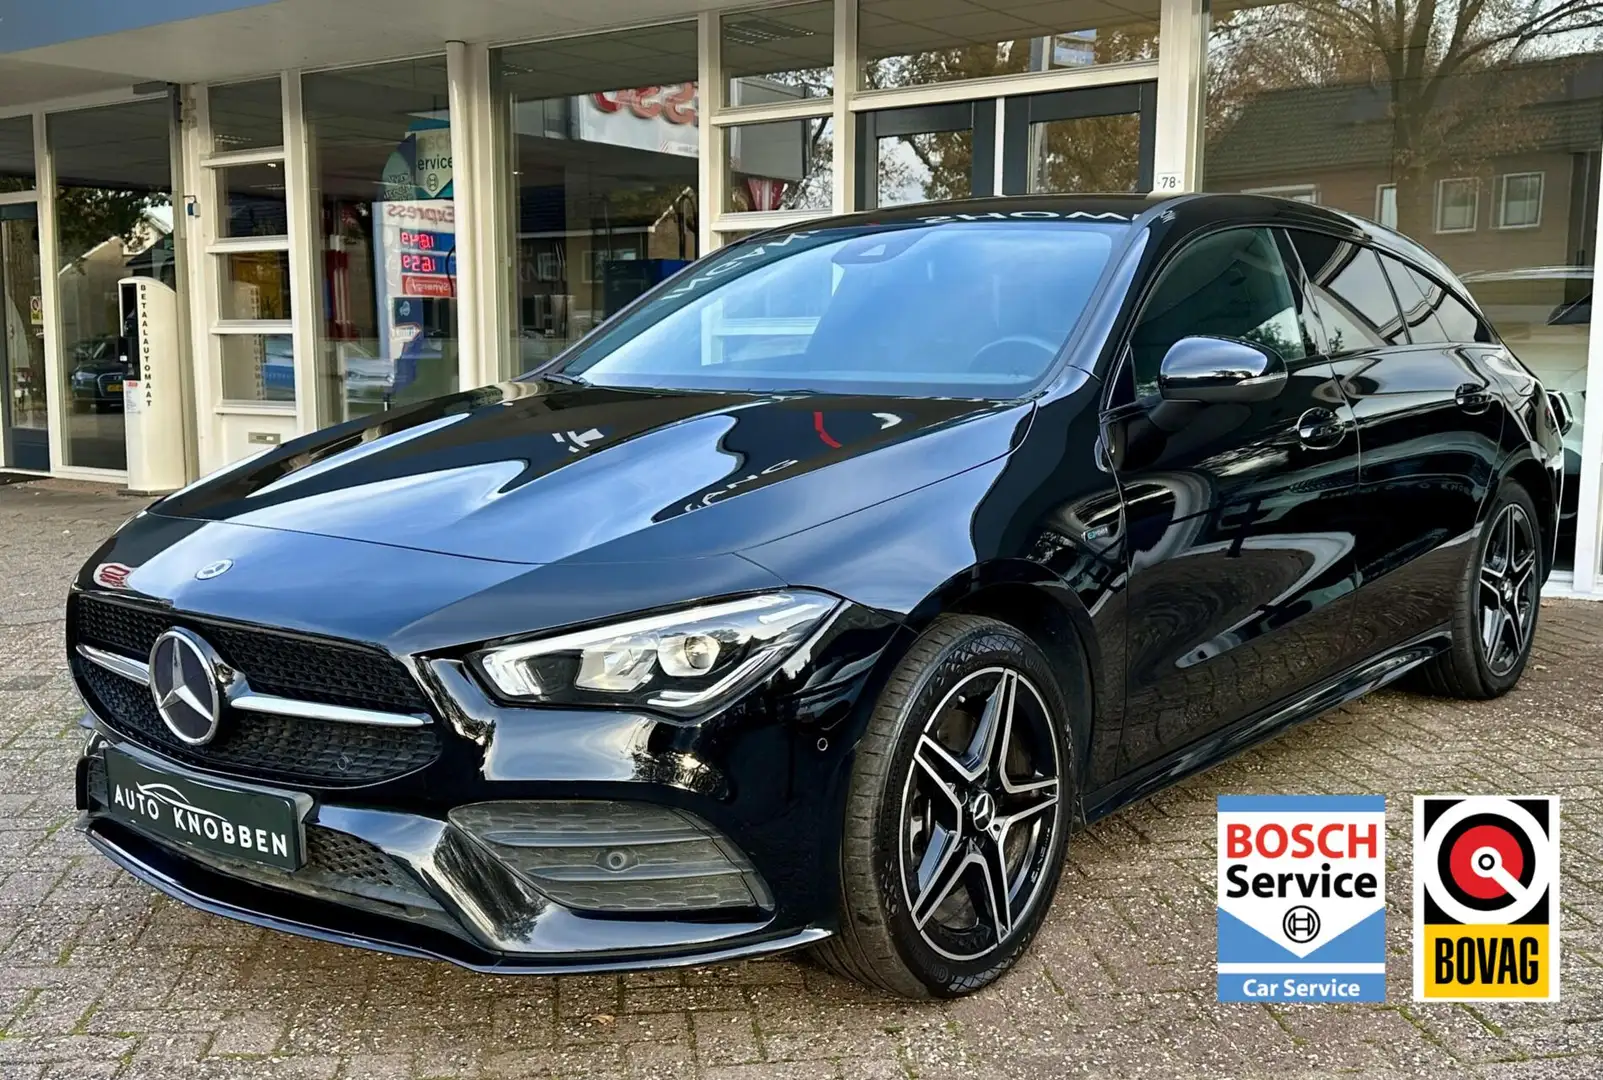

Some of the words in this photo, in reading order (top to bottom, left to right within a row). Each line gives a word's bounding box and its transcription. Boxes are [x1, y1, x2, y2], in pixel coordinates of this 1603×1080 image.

[417, 154, 452, 171] ervice
[1161, 176, 1176, 189] 78
[140, 284, 152, 407] BETAALAUTOMAAT
[114, 784, 159, 820] AUTO
[172, 807, 288, 857] KNOBBEN
